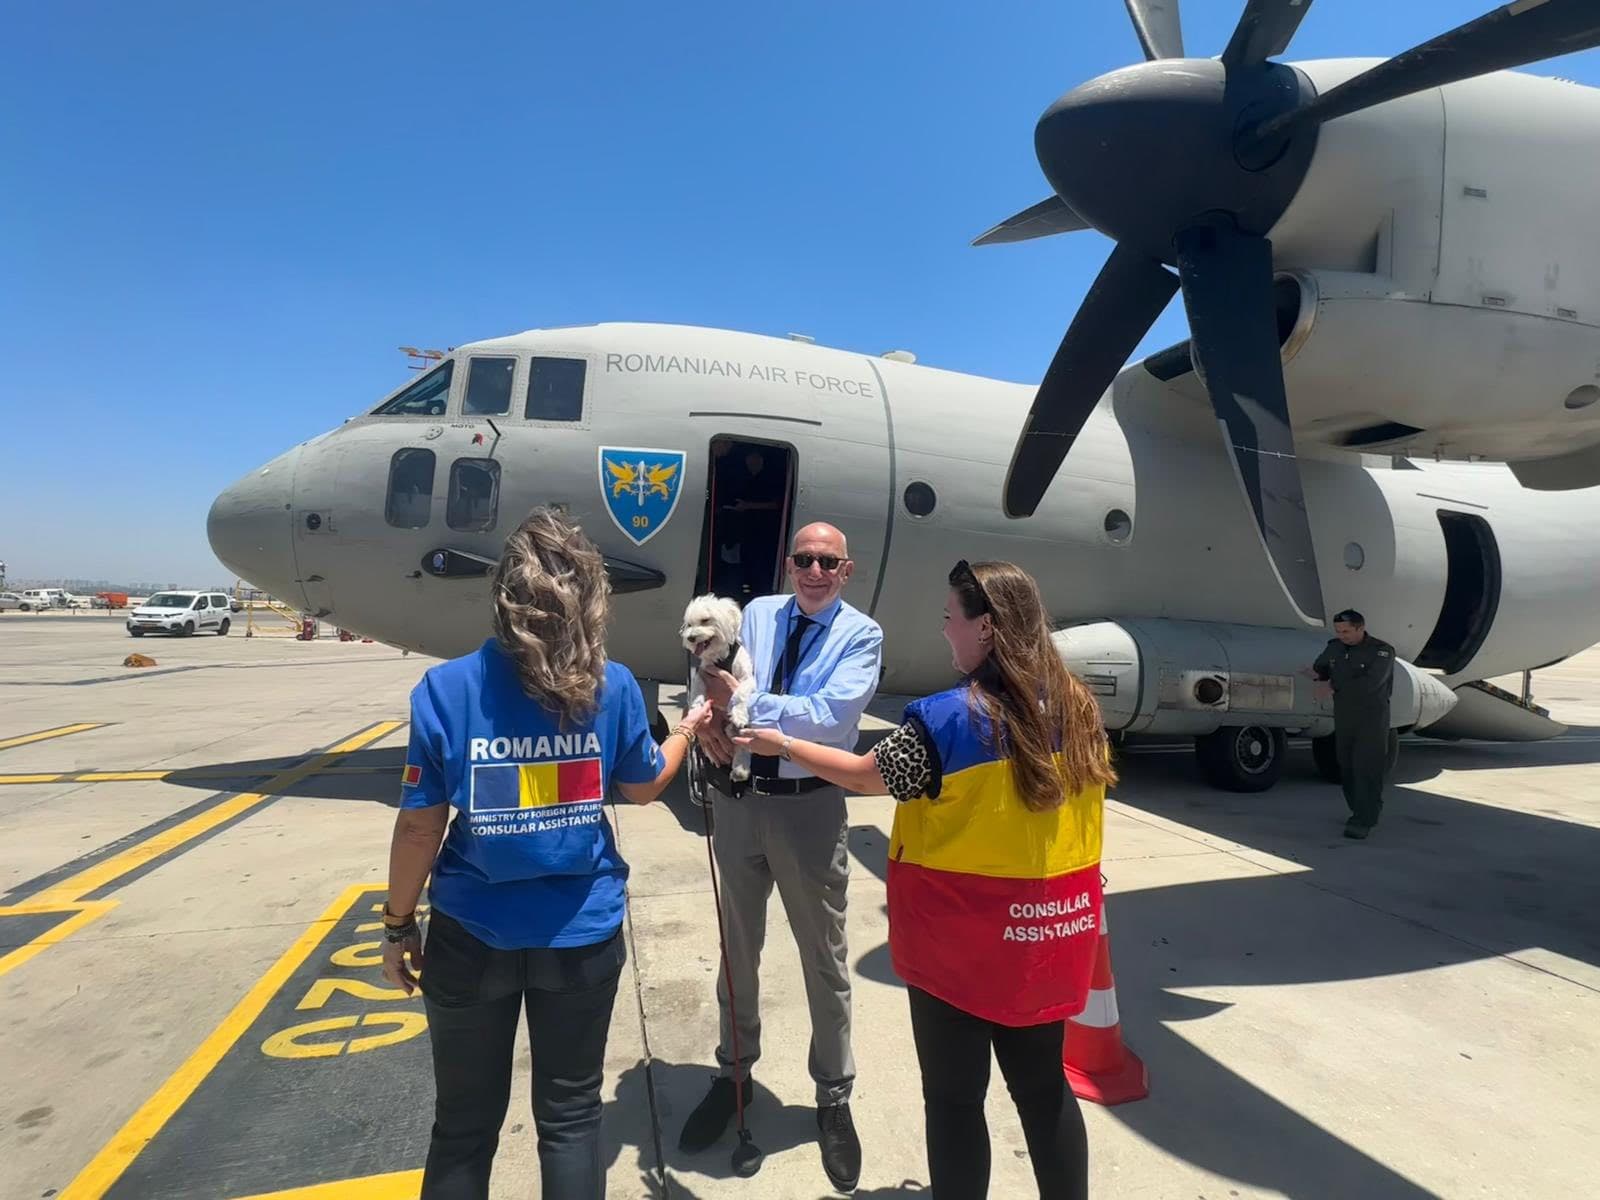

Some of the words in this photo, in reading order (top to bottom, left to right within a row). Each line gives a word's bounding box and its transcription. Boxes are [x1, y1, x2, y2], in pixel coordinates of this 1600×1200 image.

[606, 353, 742, 378] ROMANIAN
[749, 364, 788, 383] AIR
[795, 370, 874, 398] FORCE
[632, 515, 649, 528] 90
[470, 732, 601, 761] ROMANIA
[470, 814, 515, 823] MINISTRY
[516, 811, 530, 821] OF
[531, 807, 566, 819] FOREIGN
[471, 823, 536, 836] CONSULAR
[1009, 892, 1090, 918] CONSULAR
[1003, 914, 1096, 941] ASSISTANCE
